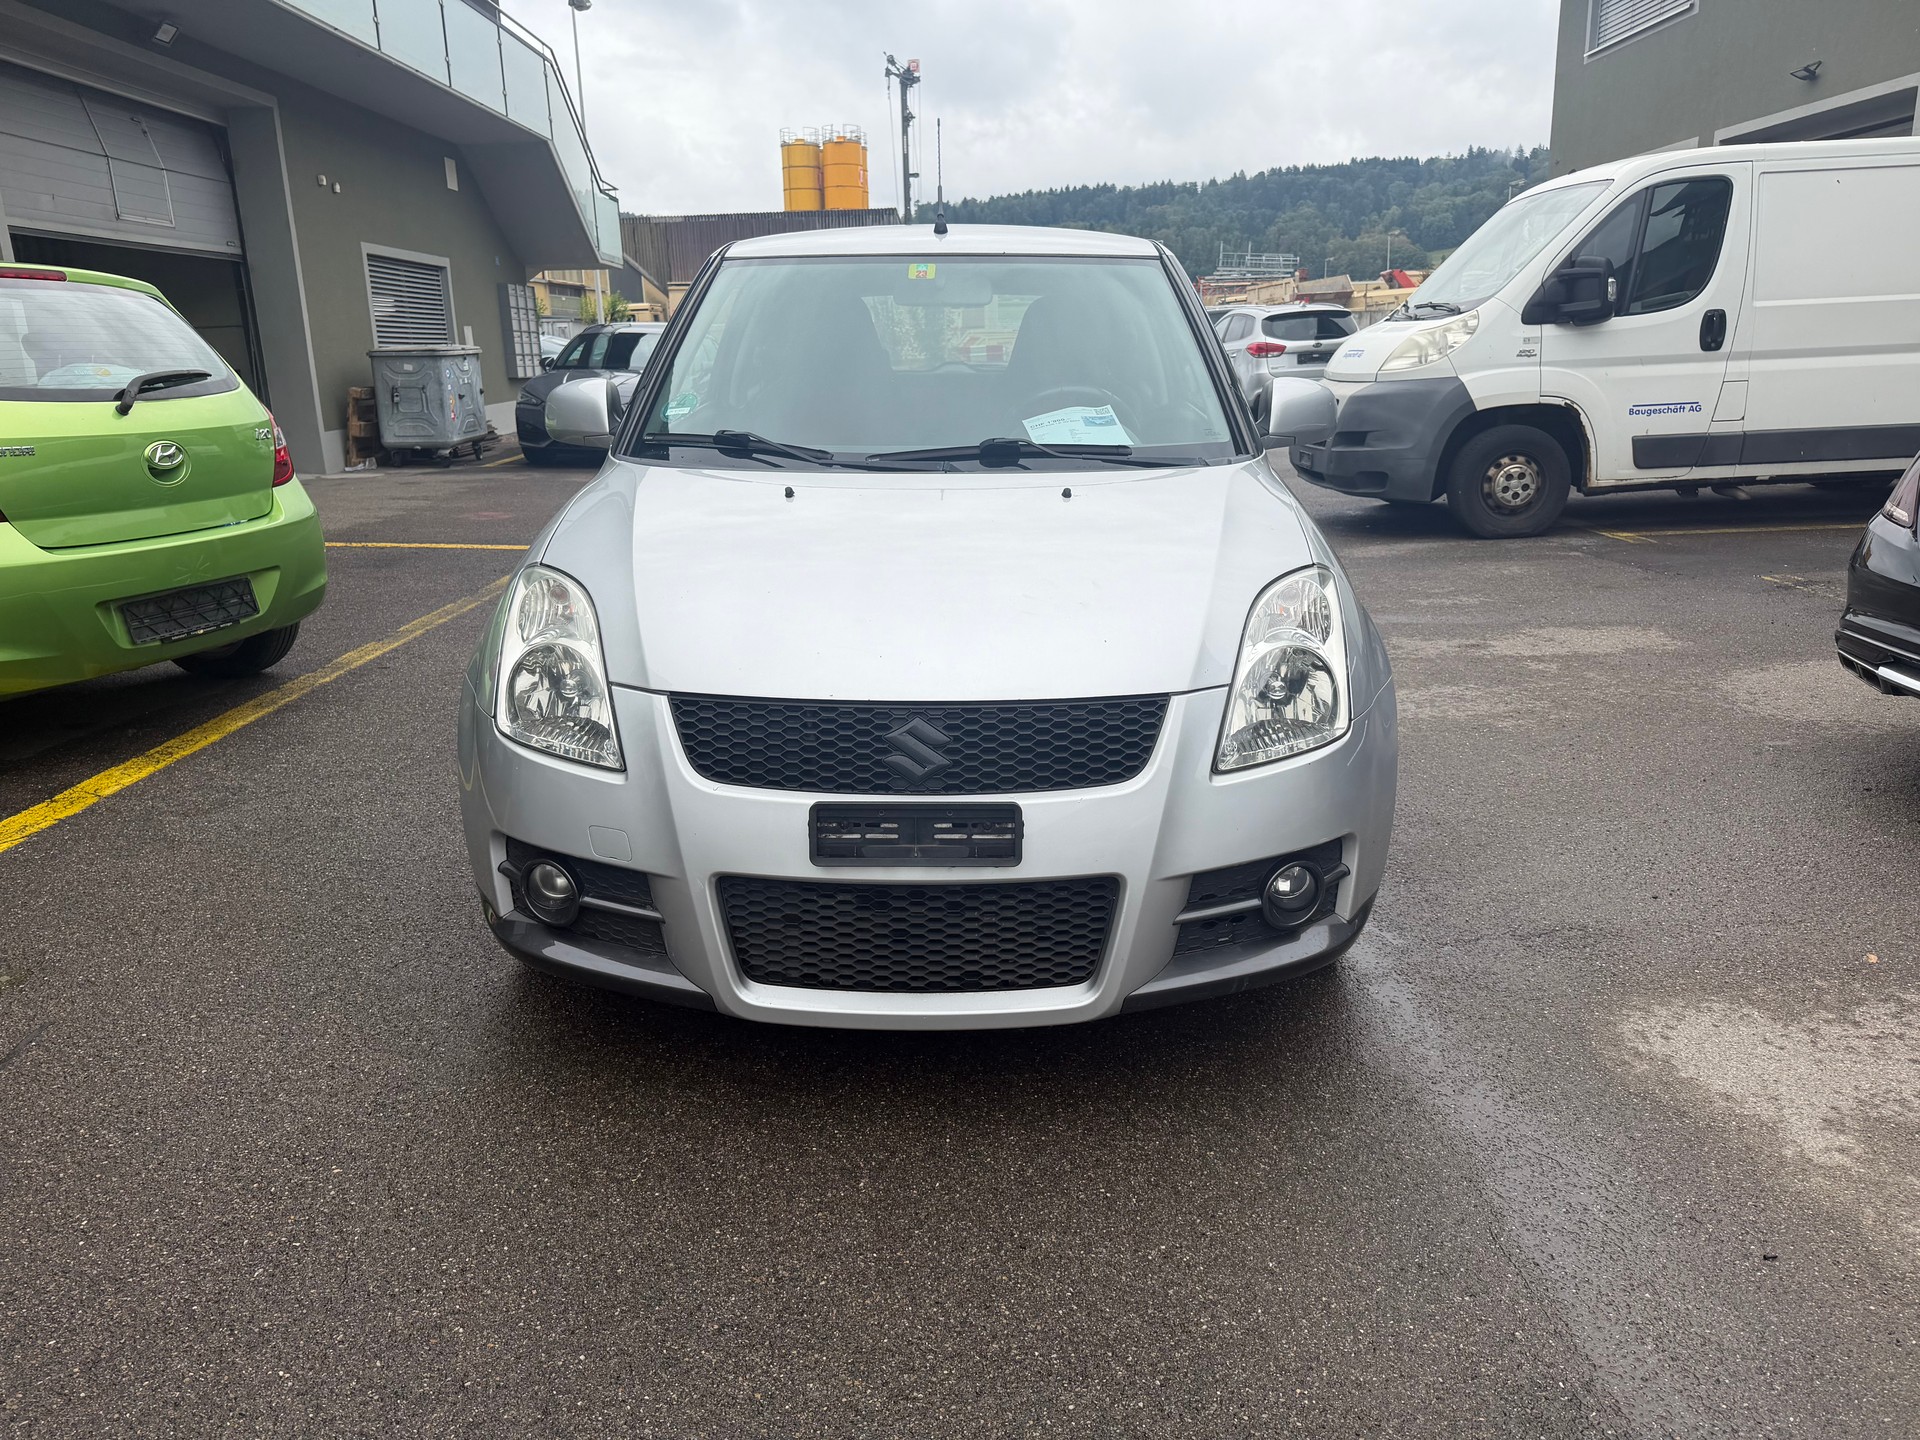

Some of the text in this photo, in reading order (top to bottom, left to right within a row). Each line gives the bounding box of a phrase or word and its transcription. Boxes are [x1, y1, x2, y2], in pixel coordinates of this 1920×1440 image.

[915, 270, 928, 279] 23
[1628, 404, 1702, 417] Baugeschäft AG
[254, 427, 272, 440] i20
[0, 445, 35, 457] NDAI
